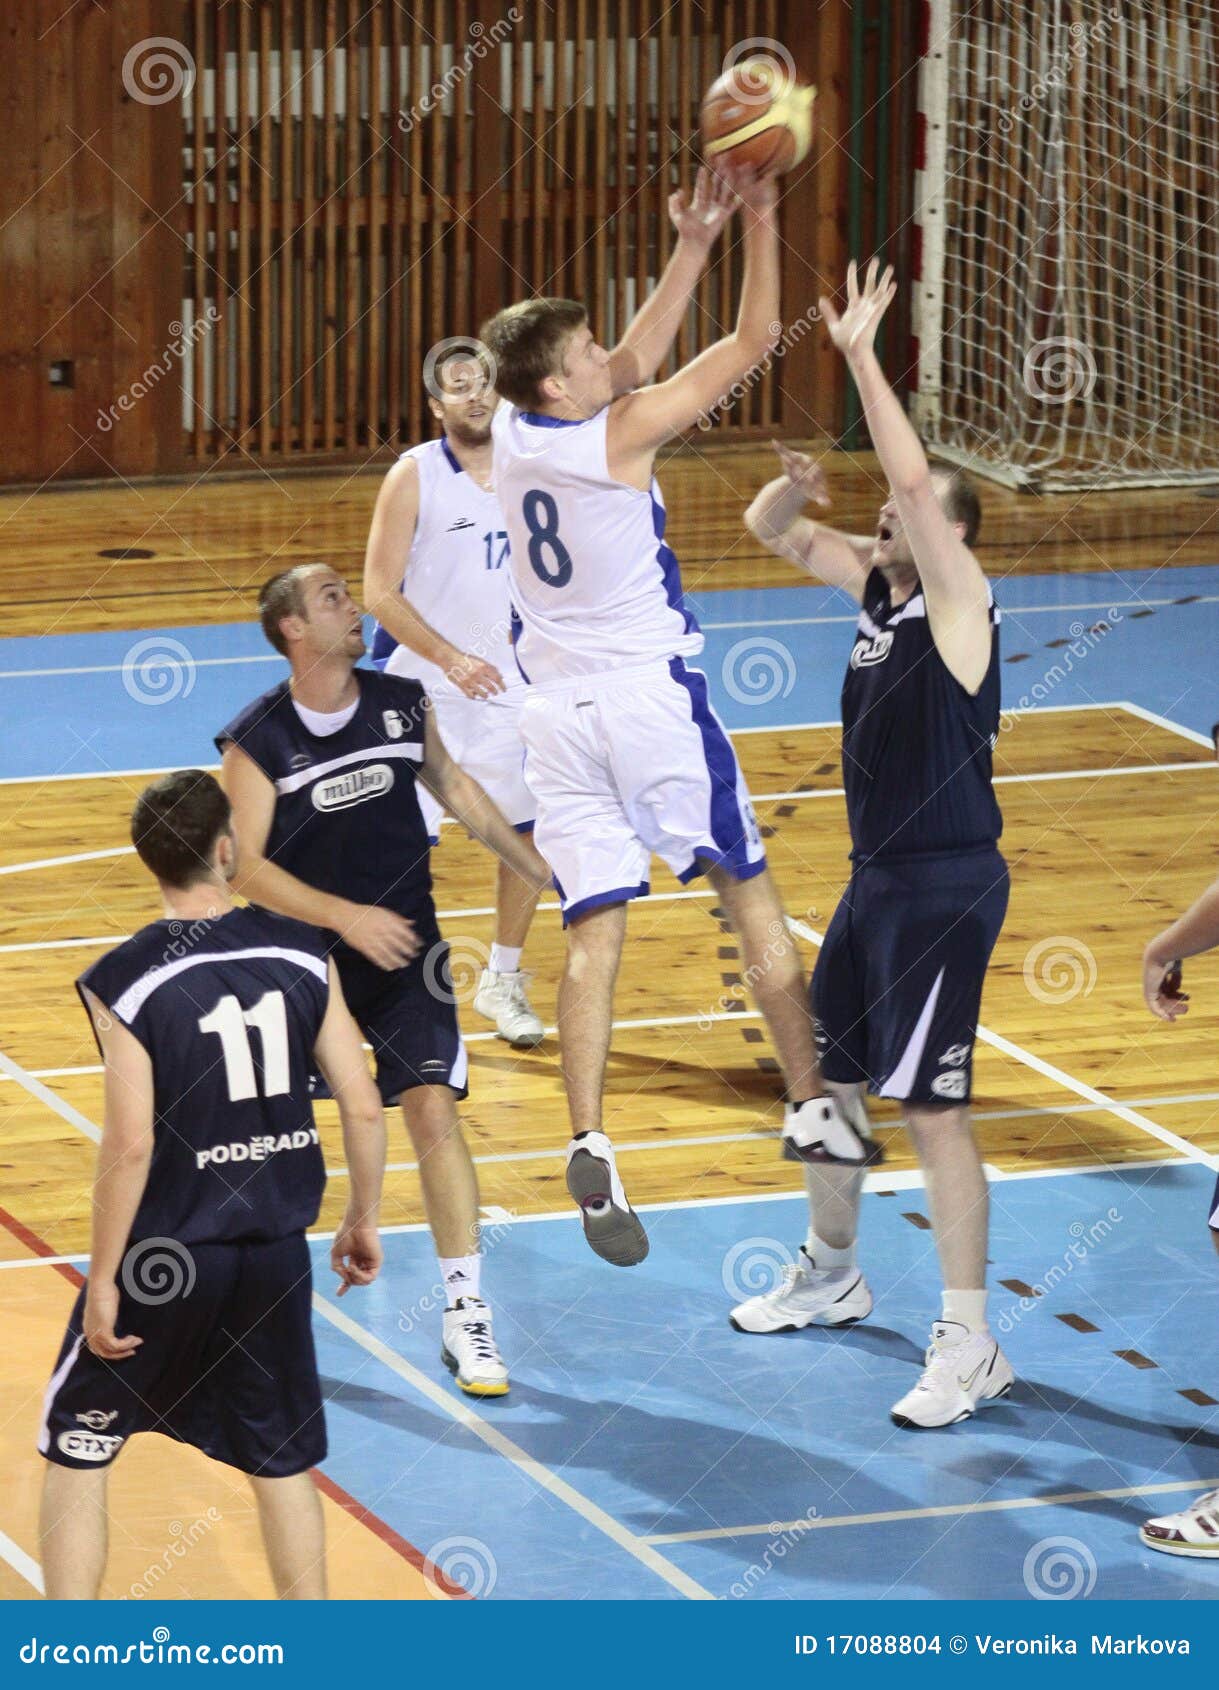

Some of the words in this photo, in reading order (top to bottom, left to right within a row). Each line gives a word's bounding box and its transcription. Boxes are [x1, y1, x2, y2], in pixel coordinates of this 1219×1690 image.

[483, 531, 511, 570] 17
[522, 489, 573, 588] 8
[382, 709, 403, 739] 6
[198, 990, 291, 1102] 11
